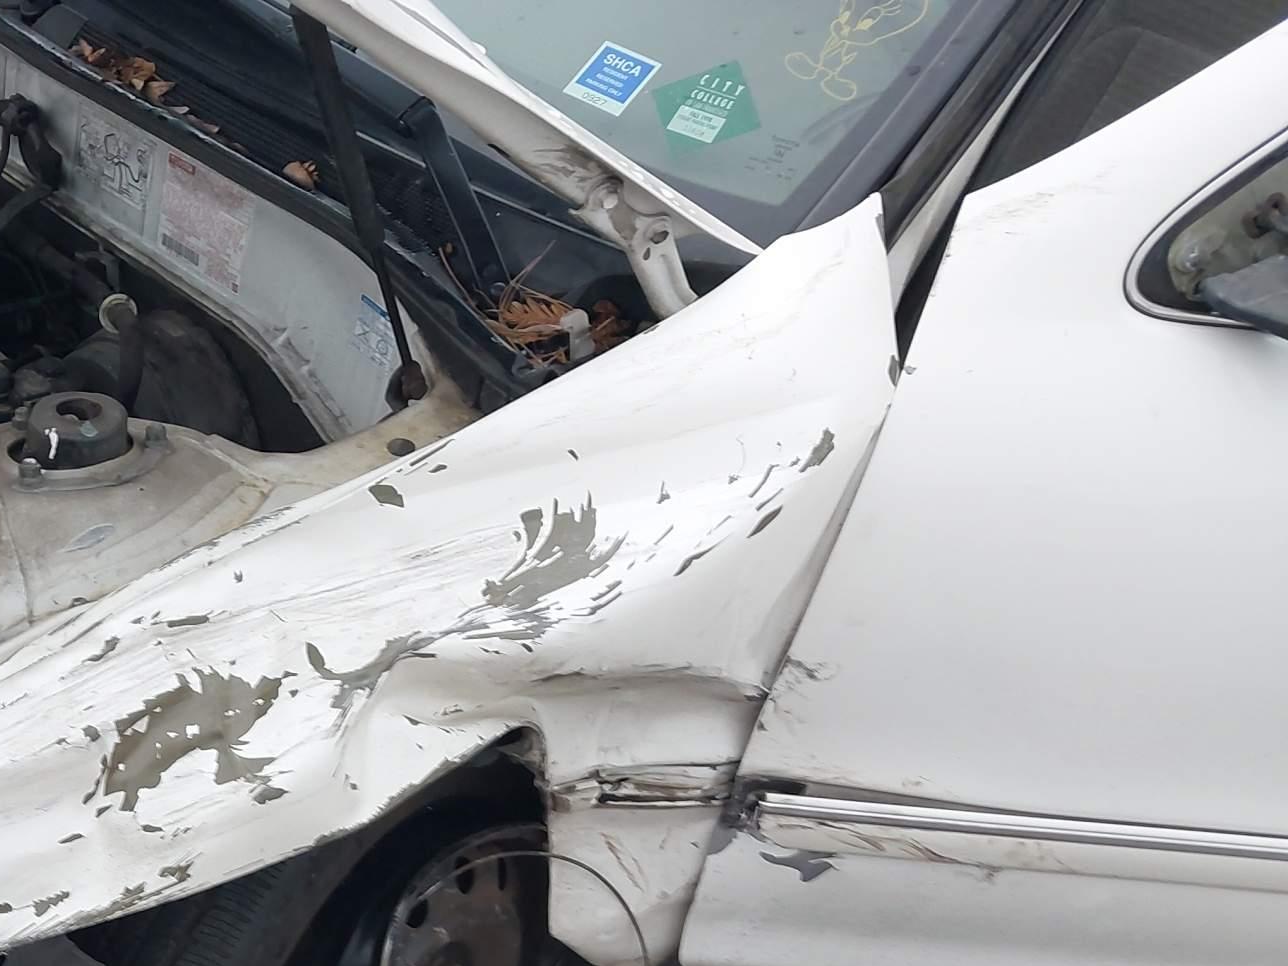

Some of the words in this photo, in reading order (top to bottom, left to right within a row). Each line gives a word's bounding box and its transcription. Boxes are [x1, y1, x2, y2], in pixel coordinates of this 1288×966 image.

[603, 53, 642, 77] SHCA
[699, 74, 745, 96] CITY
[691, 89, 735, 110] COLLEGE
